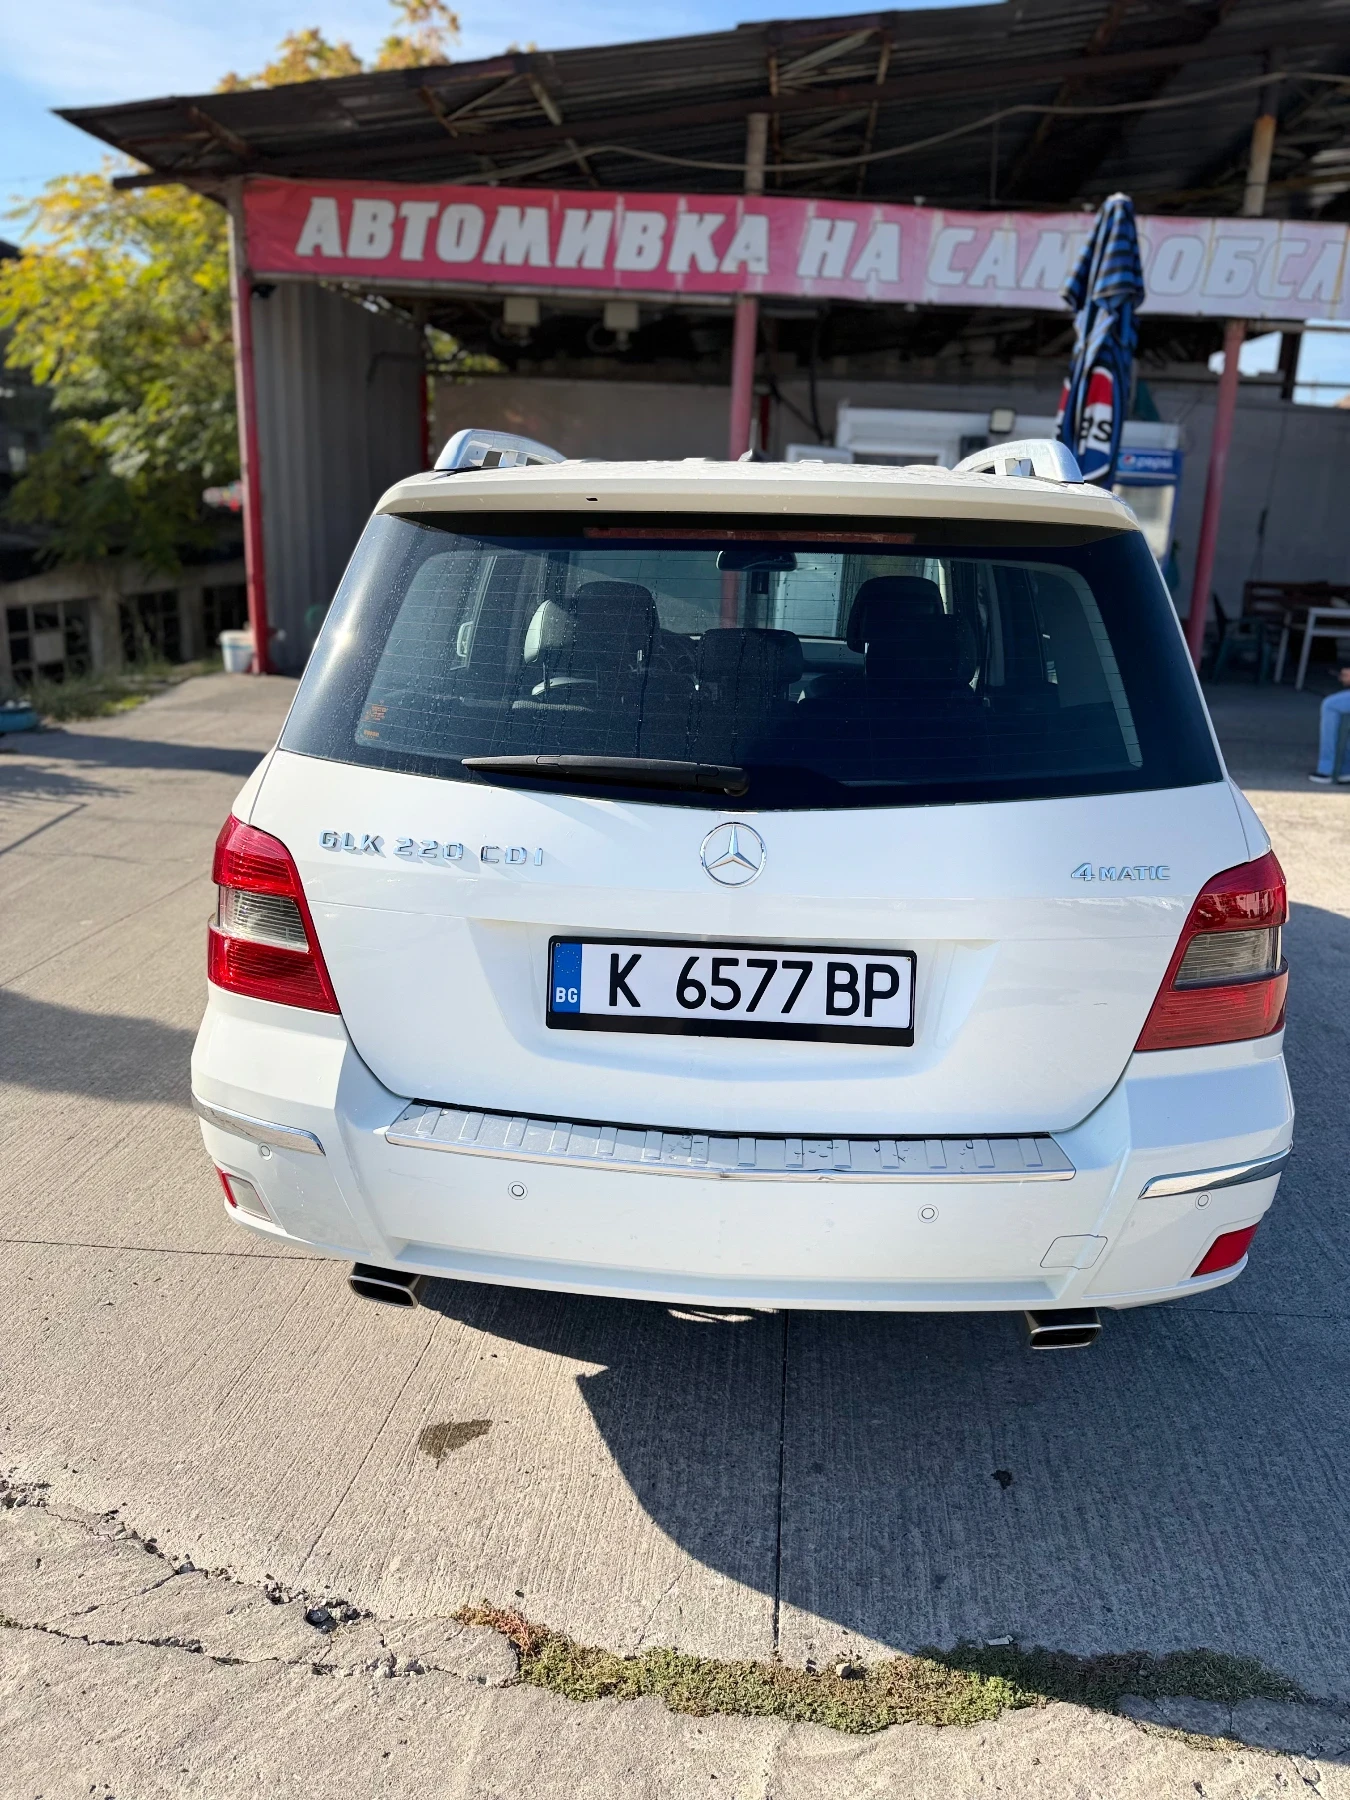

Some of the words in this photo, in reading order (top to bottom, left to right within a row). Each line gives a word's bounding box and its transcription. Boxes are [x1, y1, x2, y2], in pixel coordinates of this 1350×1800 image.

[295, 197, 769, 275] АВТОМИВКА
[796, 217, 902, 283] НА
[927, 226, 1348, 304] САМОБСЛ
[319, 829, 381, 854] GLK
[393, 836, 464, 861] 220
[480, 844, 544, 867] CDI
[555, 986, 578, 1004] BG
[608, 953, 642, 1008] K
[676, 956, 813, 1014] 6577
[825, 962, 901, 1018] BP
